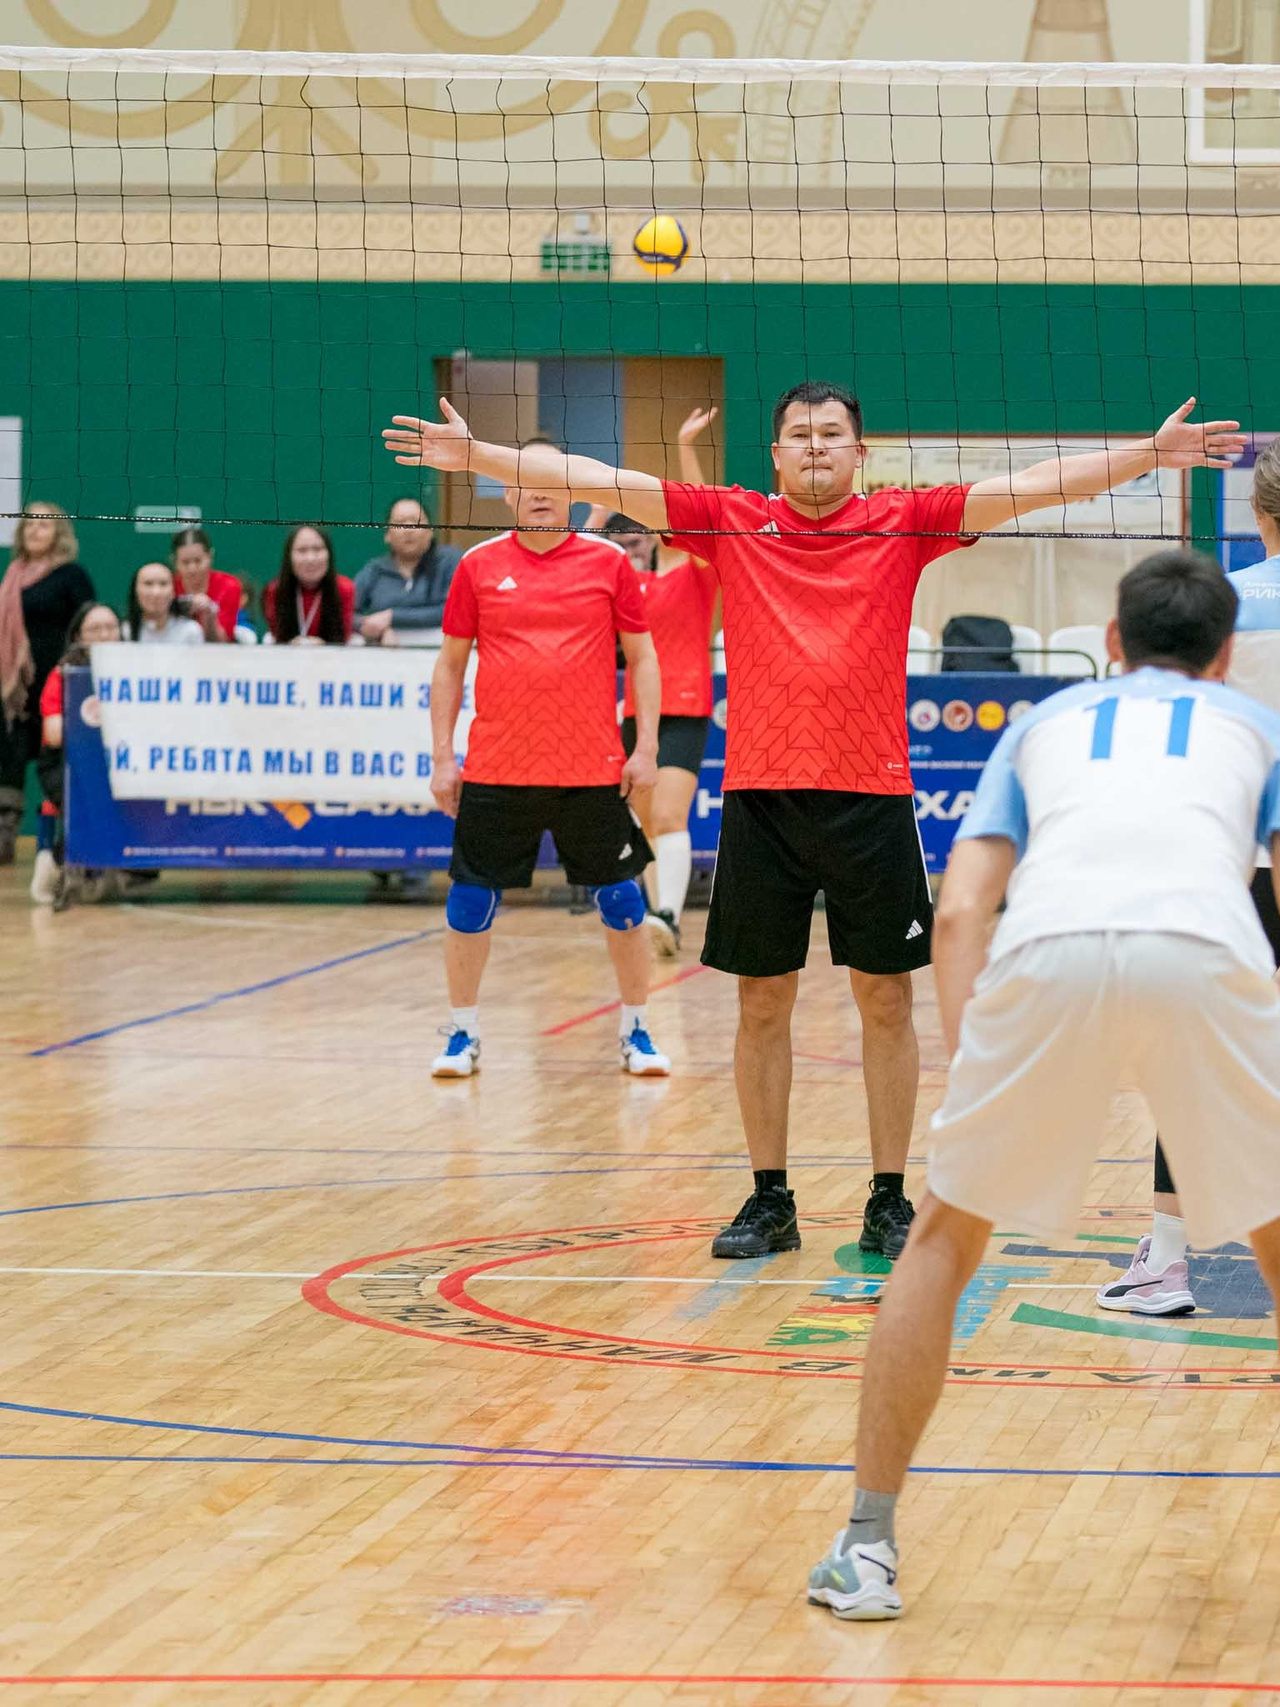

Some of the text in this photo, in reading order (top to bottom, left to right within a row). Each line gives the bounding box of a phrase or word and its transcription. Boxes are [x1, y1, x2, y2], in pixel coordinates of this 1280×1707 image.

[98, 677, 182, 704] НАШИ
[319, 680, 404, 708] НАШИ
[1083, 695, 1196, 760] 11
[149, 746, 251, 773] РЕБЯТА
[264, 748, 313, 775] МЫ
[325, 749, 339, 775] В
[352, 749, 404, 777] ВАС
